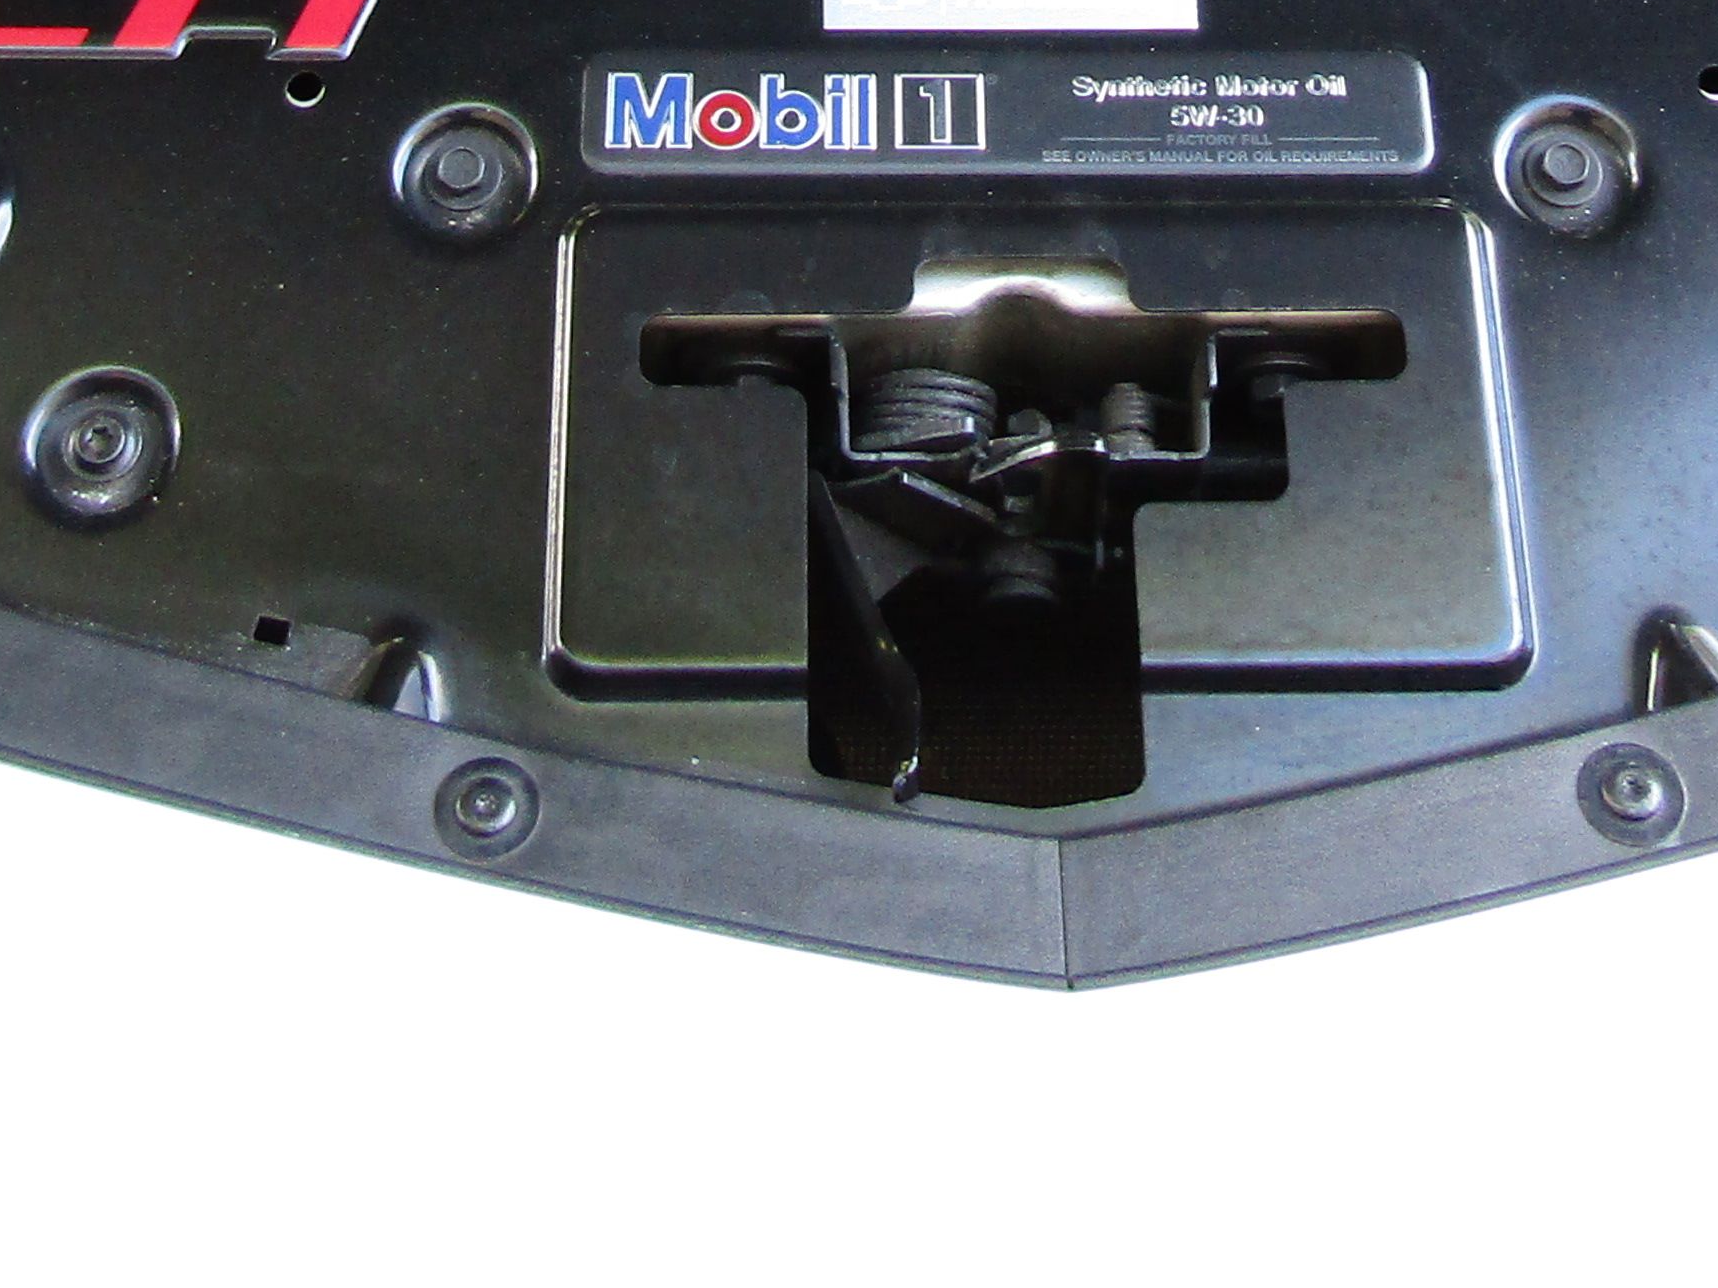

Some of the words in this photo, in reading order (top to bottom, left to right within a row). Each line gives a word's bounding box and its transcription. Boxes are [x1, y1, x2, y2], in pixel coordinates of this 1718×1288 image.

[1071, 75, 1208, 103] Synthetic
[1214, 75, 1299, 97] Motor
[1305, 74, 1347, 96] Oil
[604, 72, 877, 150] Mobil
[1170, 104, 1265, 127] 5W-30
[1166, 134, 1238, 146] FACTORY
[1242, 134, 1273, 146] FILL
[1041, 150, 1073, 163] SEE
[1075, 150, 1146, 163] OWNER'S
[1149, 150, 1214, 163] MANUAL
[1218, 150, 1249, 162] FOR
[1252, 150, 1278, 163] OIL
[1281, 150, 1400, 163] REQUIREMENTS
